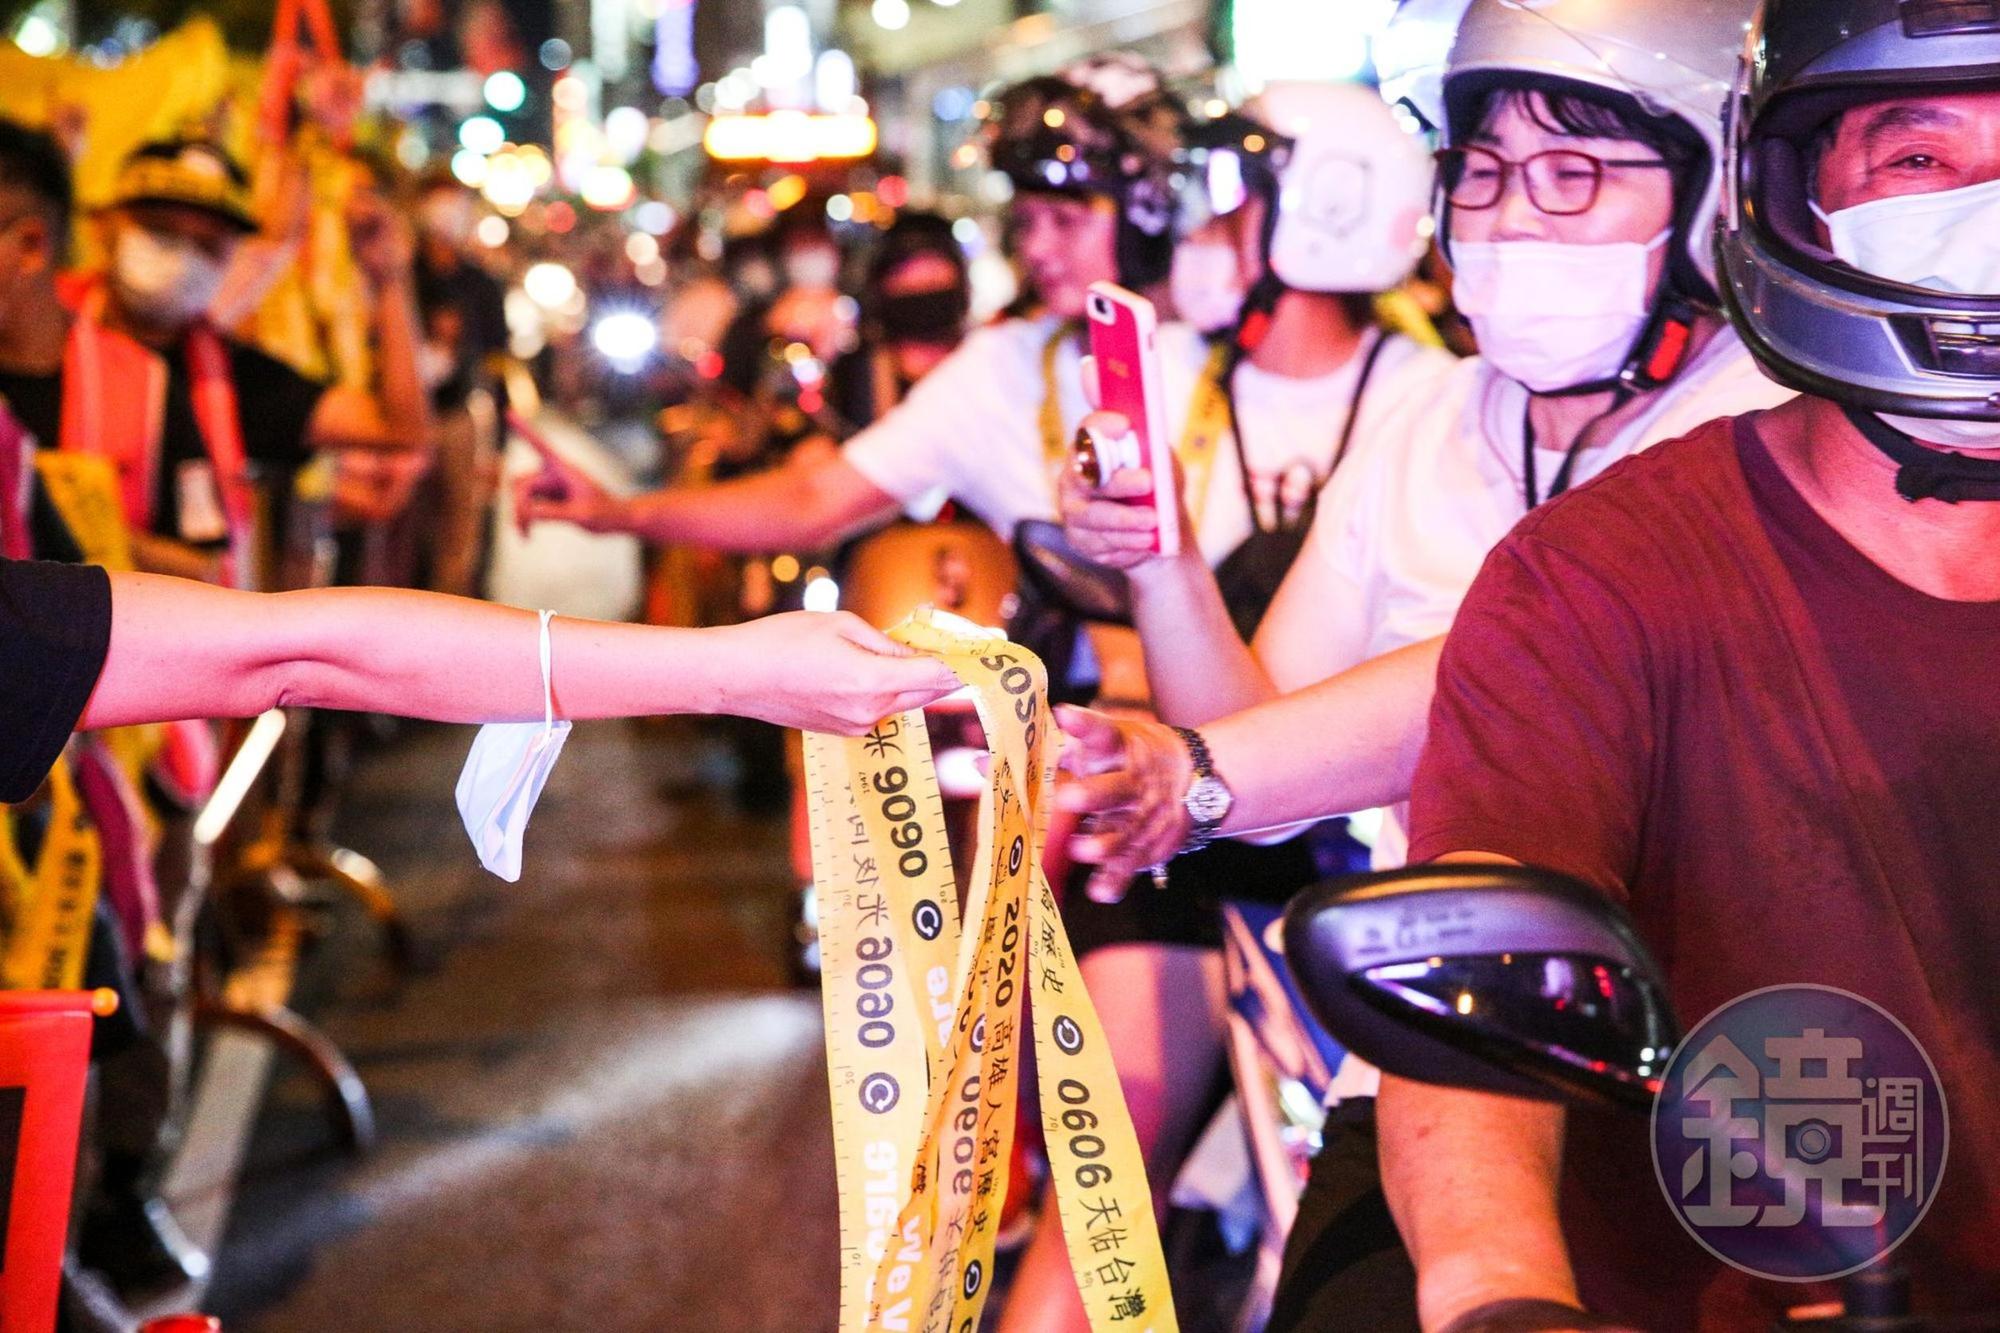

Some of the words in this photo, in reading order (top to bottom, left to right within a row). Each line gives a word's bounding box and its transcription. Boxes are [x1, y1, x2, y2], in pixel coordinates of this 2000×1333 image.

[1057, 1078, 1113, 1188] 0606
[1079, 1196, 1147, 1322] 天佑台灣
